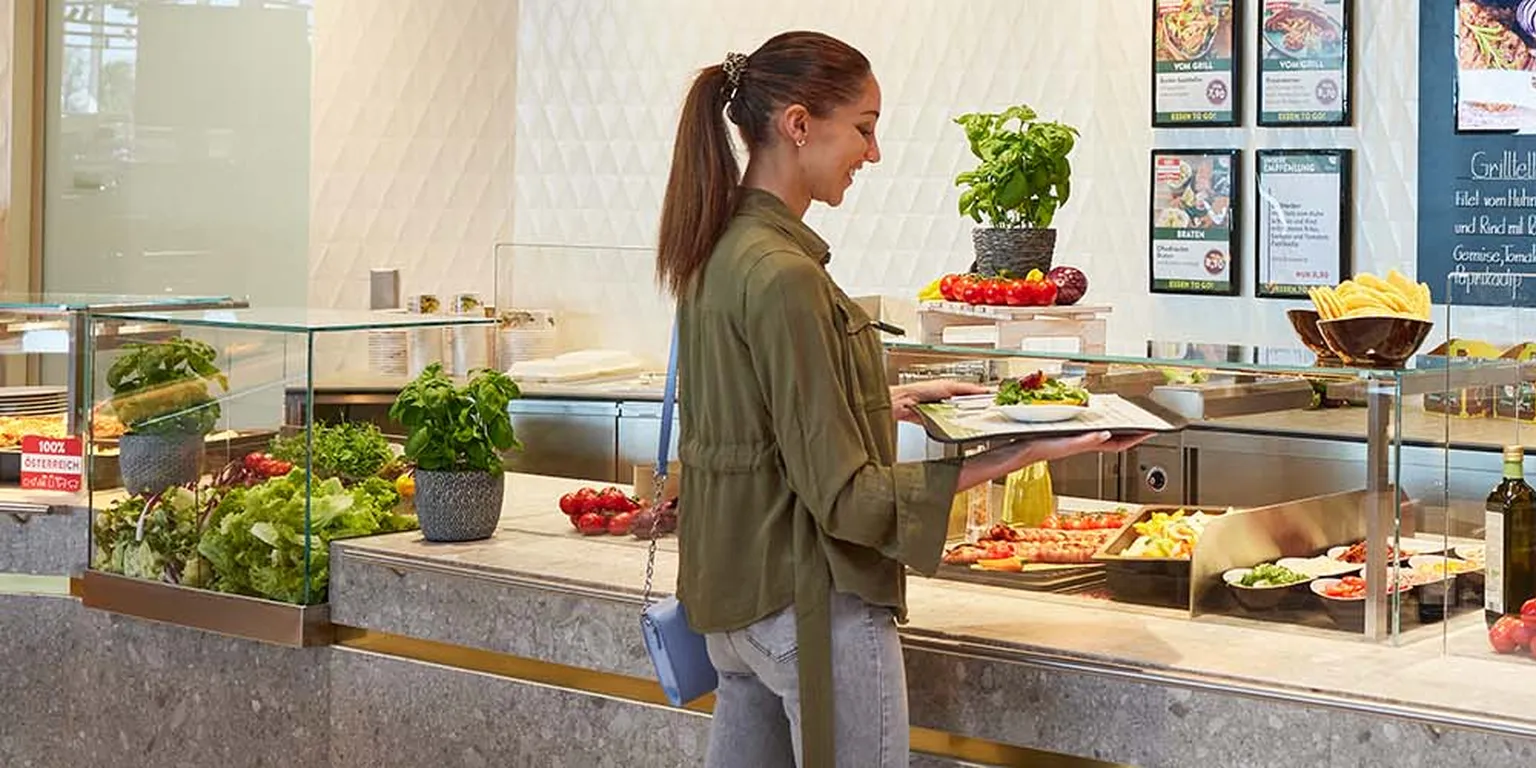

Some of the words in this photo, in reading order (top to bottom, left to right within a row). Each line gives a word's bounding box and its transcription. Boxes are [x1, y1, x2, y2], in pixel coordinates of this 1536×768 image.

[1455, 189, 1479, 207] Filet
[1484, 196, 1506, 207] vom
[1454, 216, 1476, 234] und
[1479, 215, 1506, 234] Rind
[1508, 216, 1524, 234] mit
[1177, 230, 1206, 239] BRATEN
[38, 440, 66, 454] 100%
[24, 457, 80, 471] ÖSTERREICH
